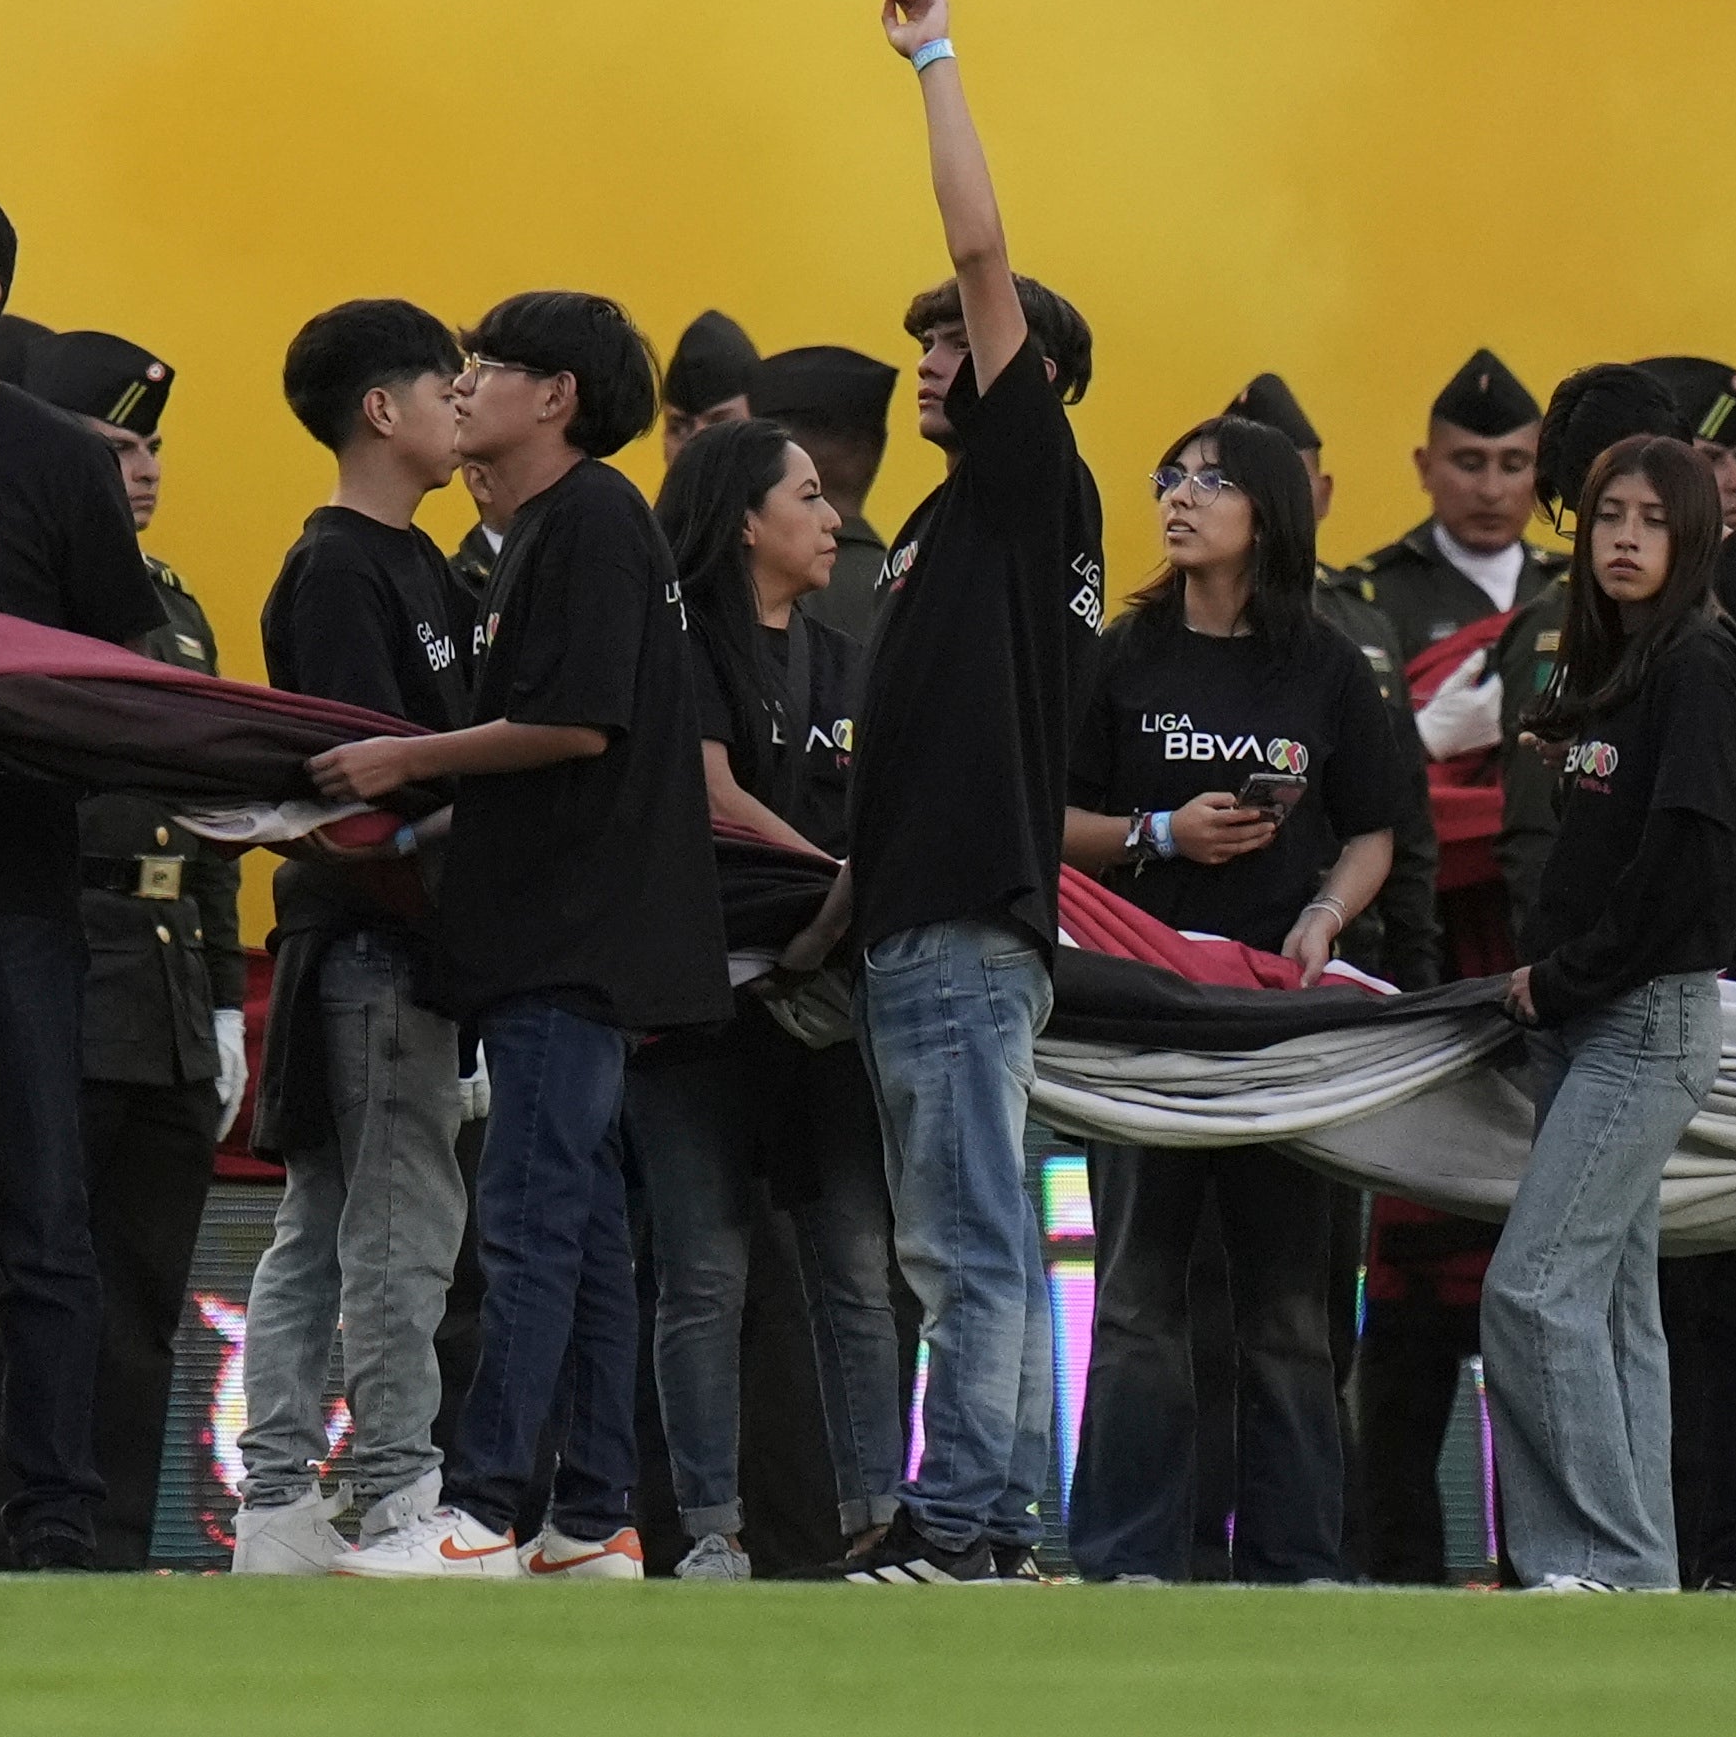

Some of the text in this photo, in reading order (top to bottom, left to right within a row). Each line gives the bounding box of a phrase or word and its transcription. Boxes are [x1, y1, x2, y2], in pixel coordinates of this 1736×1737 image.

[416, 620, 436, 644] GA
[1141, 713, 1194, 733] LIGA
[1164, 732, 1264, 762] BBVA
